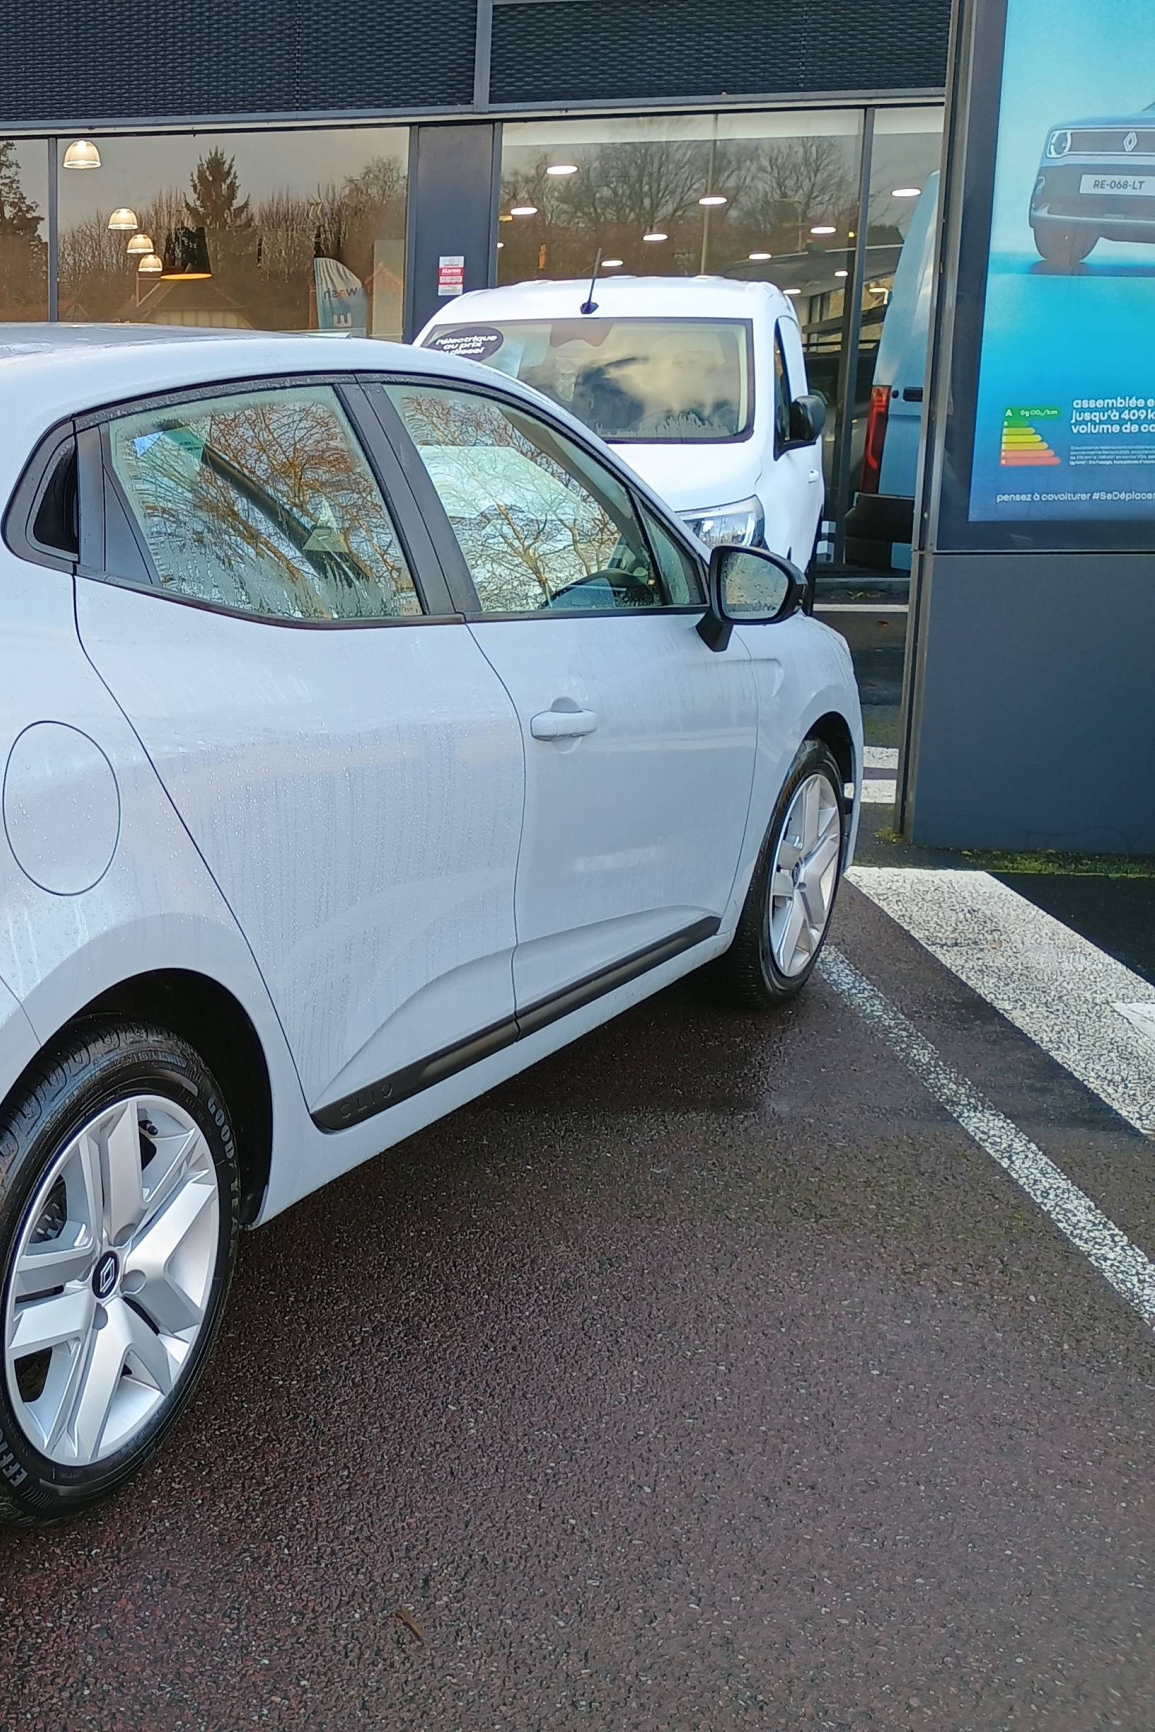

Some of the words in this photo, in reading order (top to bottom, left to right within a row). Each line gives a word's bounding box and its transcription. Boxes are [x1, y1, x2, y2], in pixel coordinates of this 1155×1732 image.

[1093, 180, 1145, 190] RE-068-LT
[1073, 397, 1144, 408] assemblée
[1005, 409, 1012, 417] A
[1121, 409, 1147, 421] 409
[1071, 422, 1121, 434] volume
[1122, 422, 1139, 433] de
[997, 493, 1032, 503] pensez
[1033, 491, 1041, 501] à
[1042, 490, 1092, 501] covoiturer
